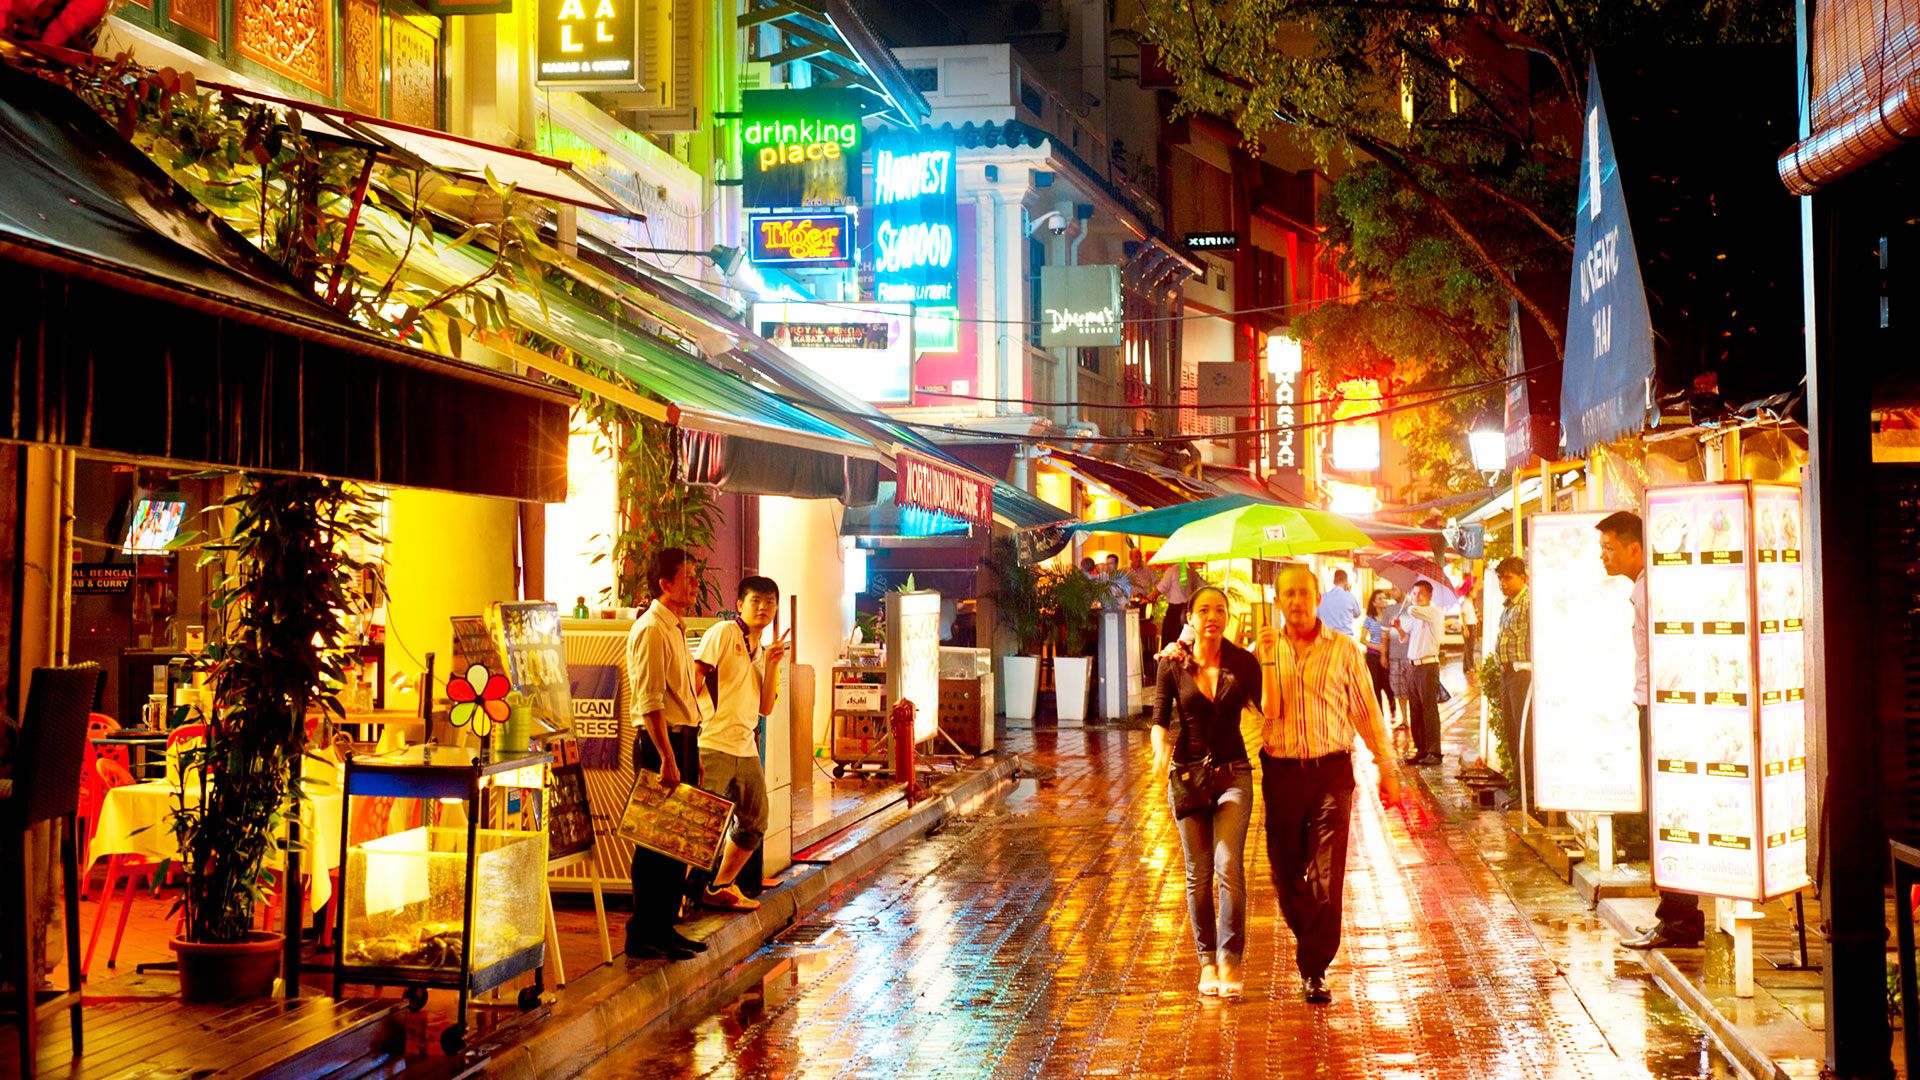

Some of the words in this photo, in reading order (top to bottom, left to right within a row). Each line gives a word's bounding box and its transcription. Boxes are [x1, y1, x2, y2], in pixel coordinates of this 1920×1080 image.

[745, 119, 856, 148] drinking
[759, 140, 841, 172] place
[875, 150, 951, 204] HARVEST
[761, 219, 839, 258] Tiger
[876, 219, 953, 273] SEAFOOD
[878, 282, 952, 301] Restaurant
[790, 326, 824, 336] ROYAL
[1045, 306, 1115, 334] Dharma's
[89, 569, 134, 578] BENGAL
[96, 580, 129, 588] CURRY
